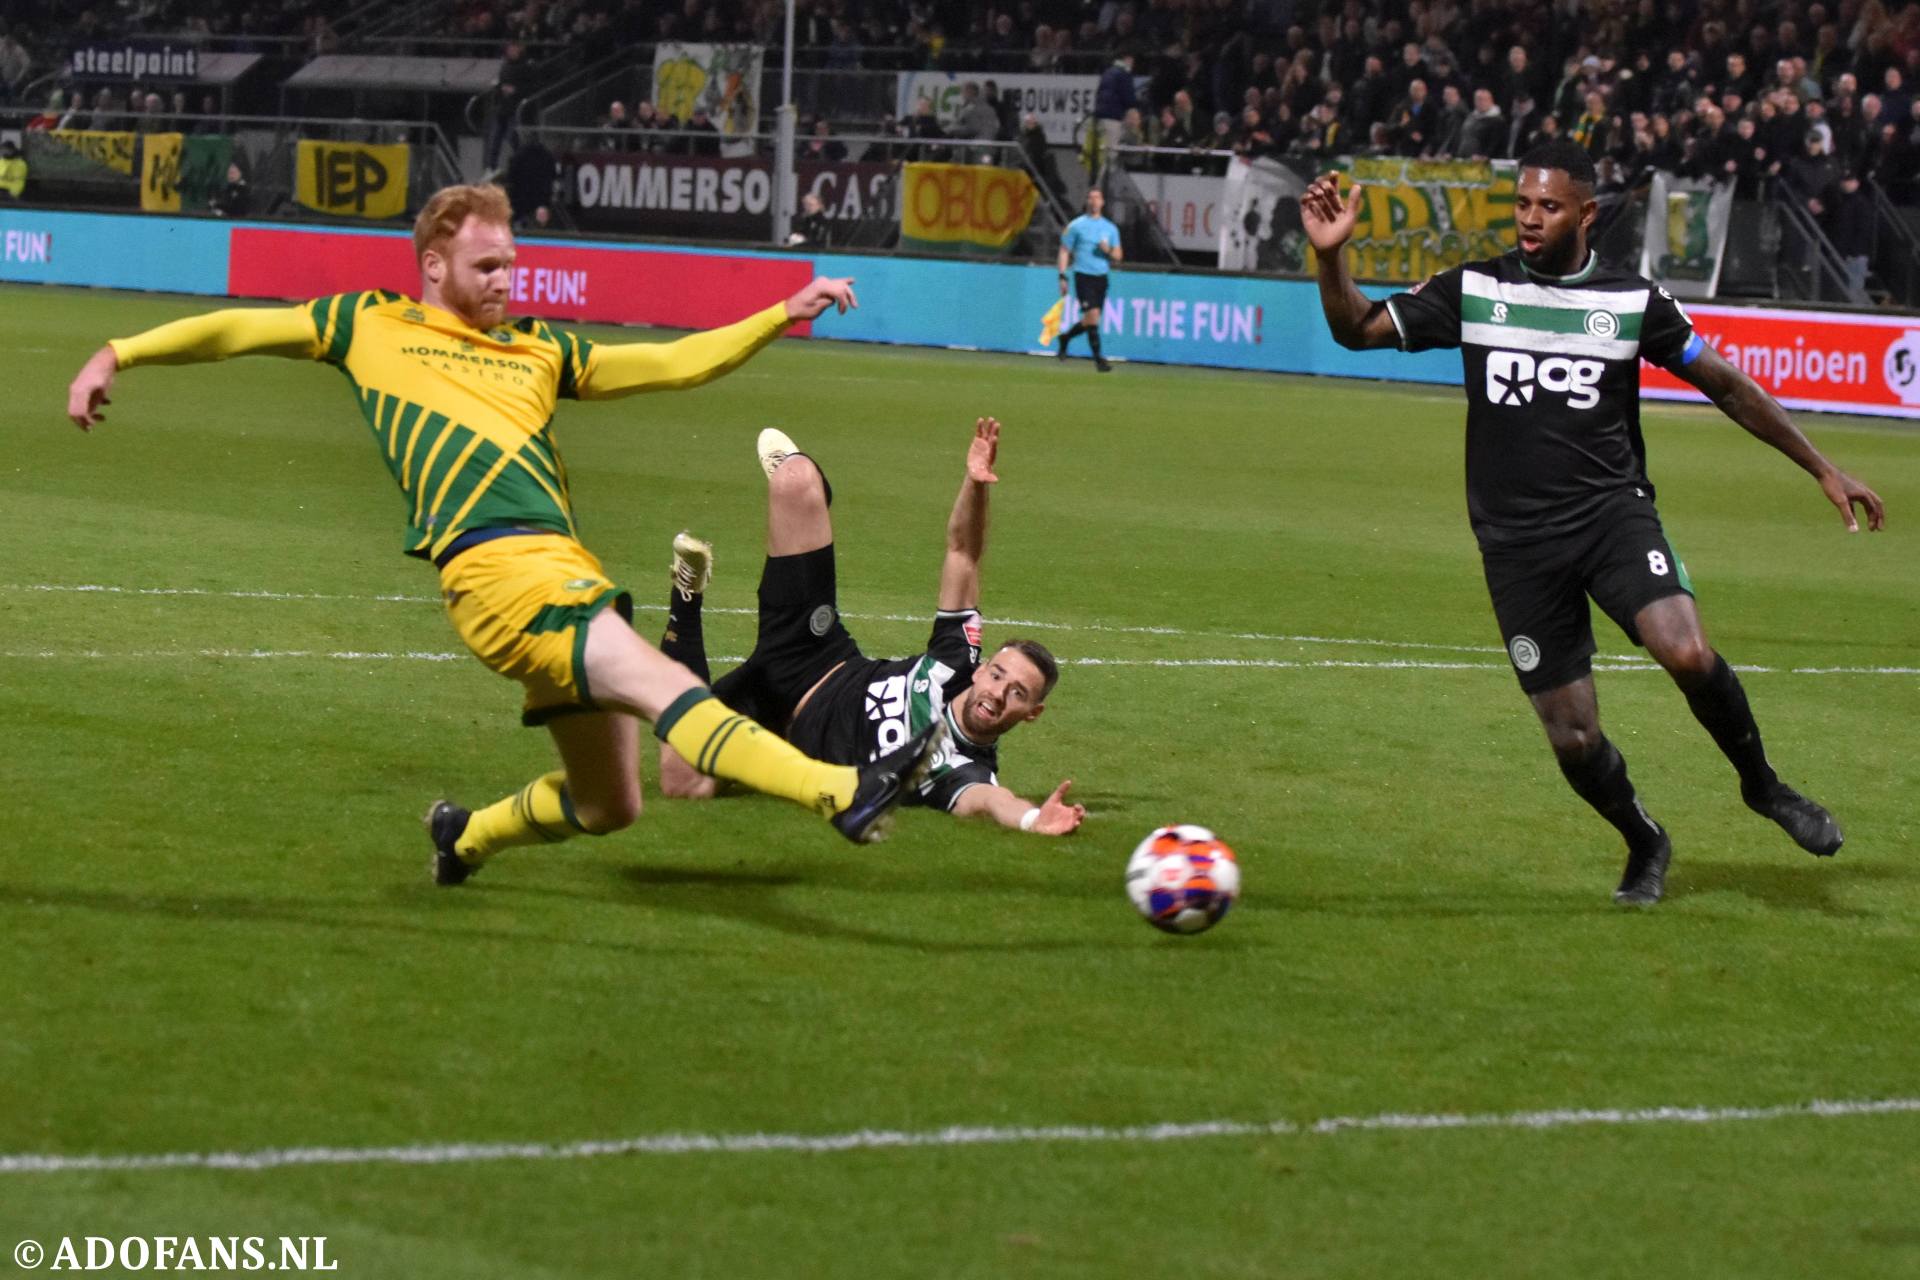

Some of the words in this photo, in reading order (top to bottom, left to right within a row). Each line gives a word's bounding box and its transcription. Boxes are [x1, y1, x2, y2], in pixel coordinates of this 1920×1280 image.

[73, 46, 195, 80] steelpoint
[314, 146, 389, 212] IEP
[5, 230, 52, 263] FUN!
[533, 268, 587, 304] FUN!
[1132, 298, 1185, 338] THE
[1192, 303, 1263, 344] FUN!
[402, 346, 533, 375] HOMMERSON
[1647, 549, 1669, 576] 8
